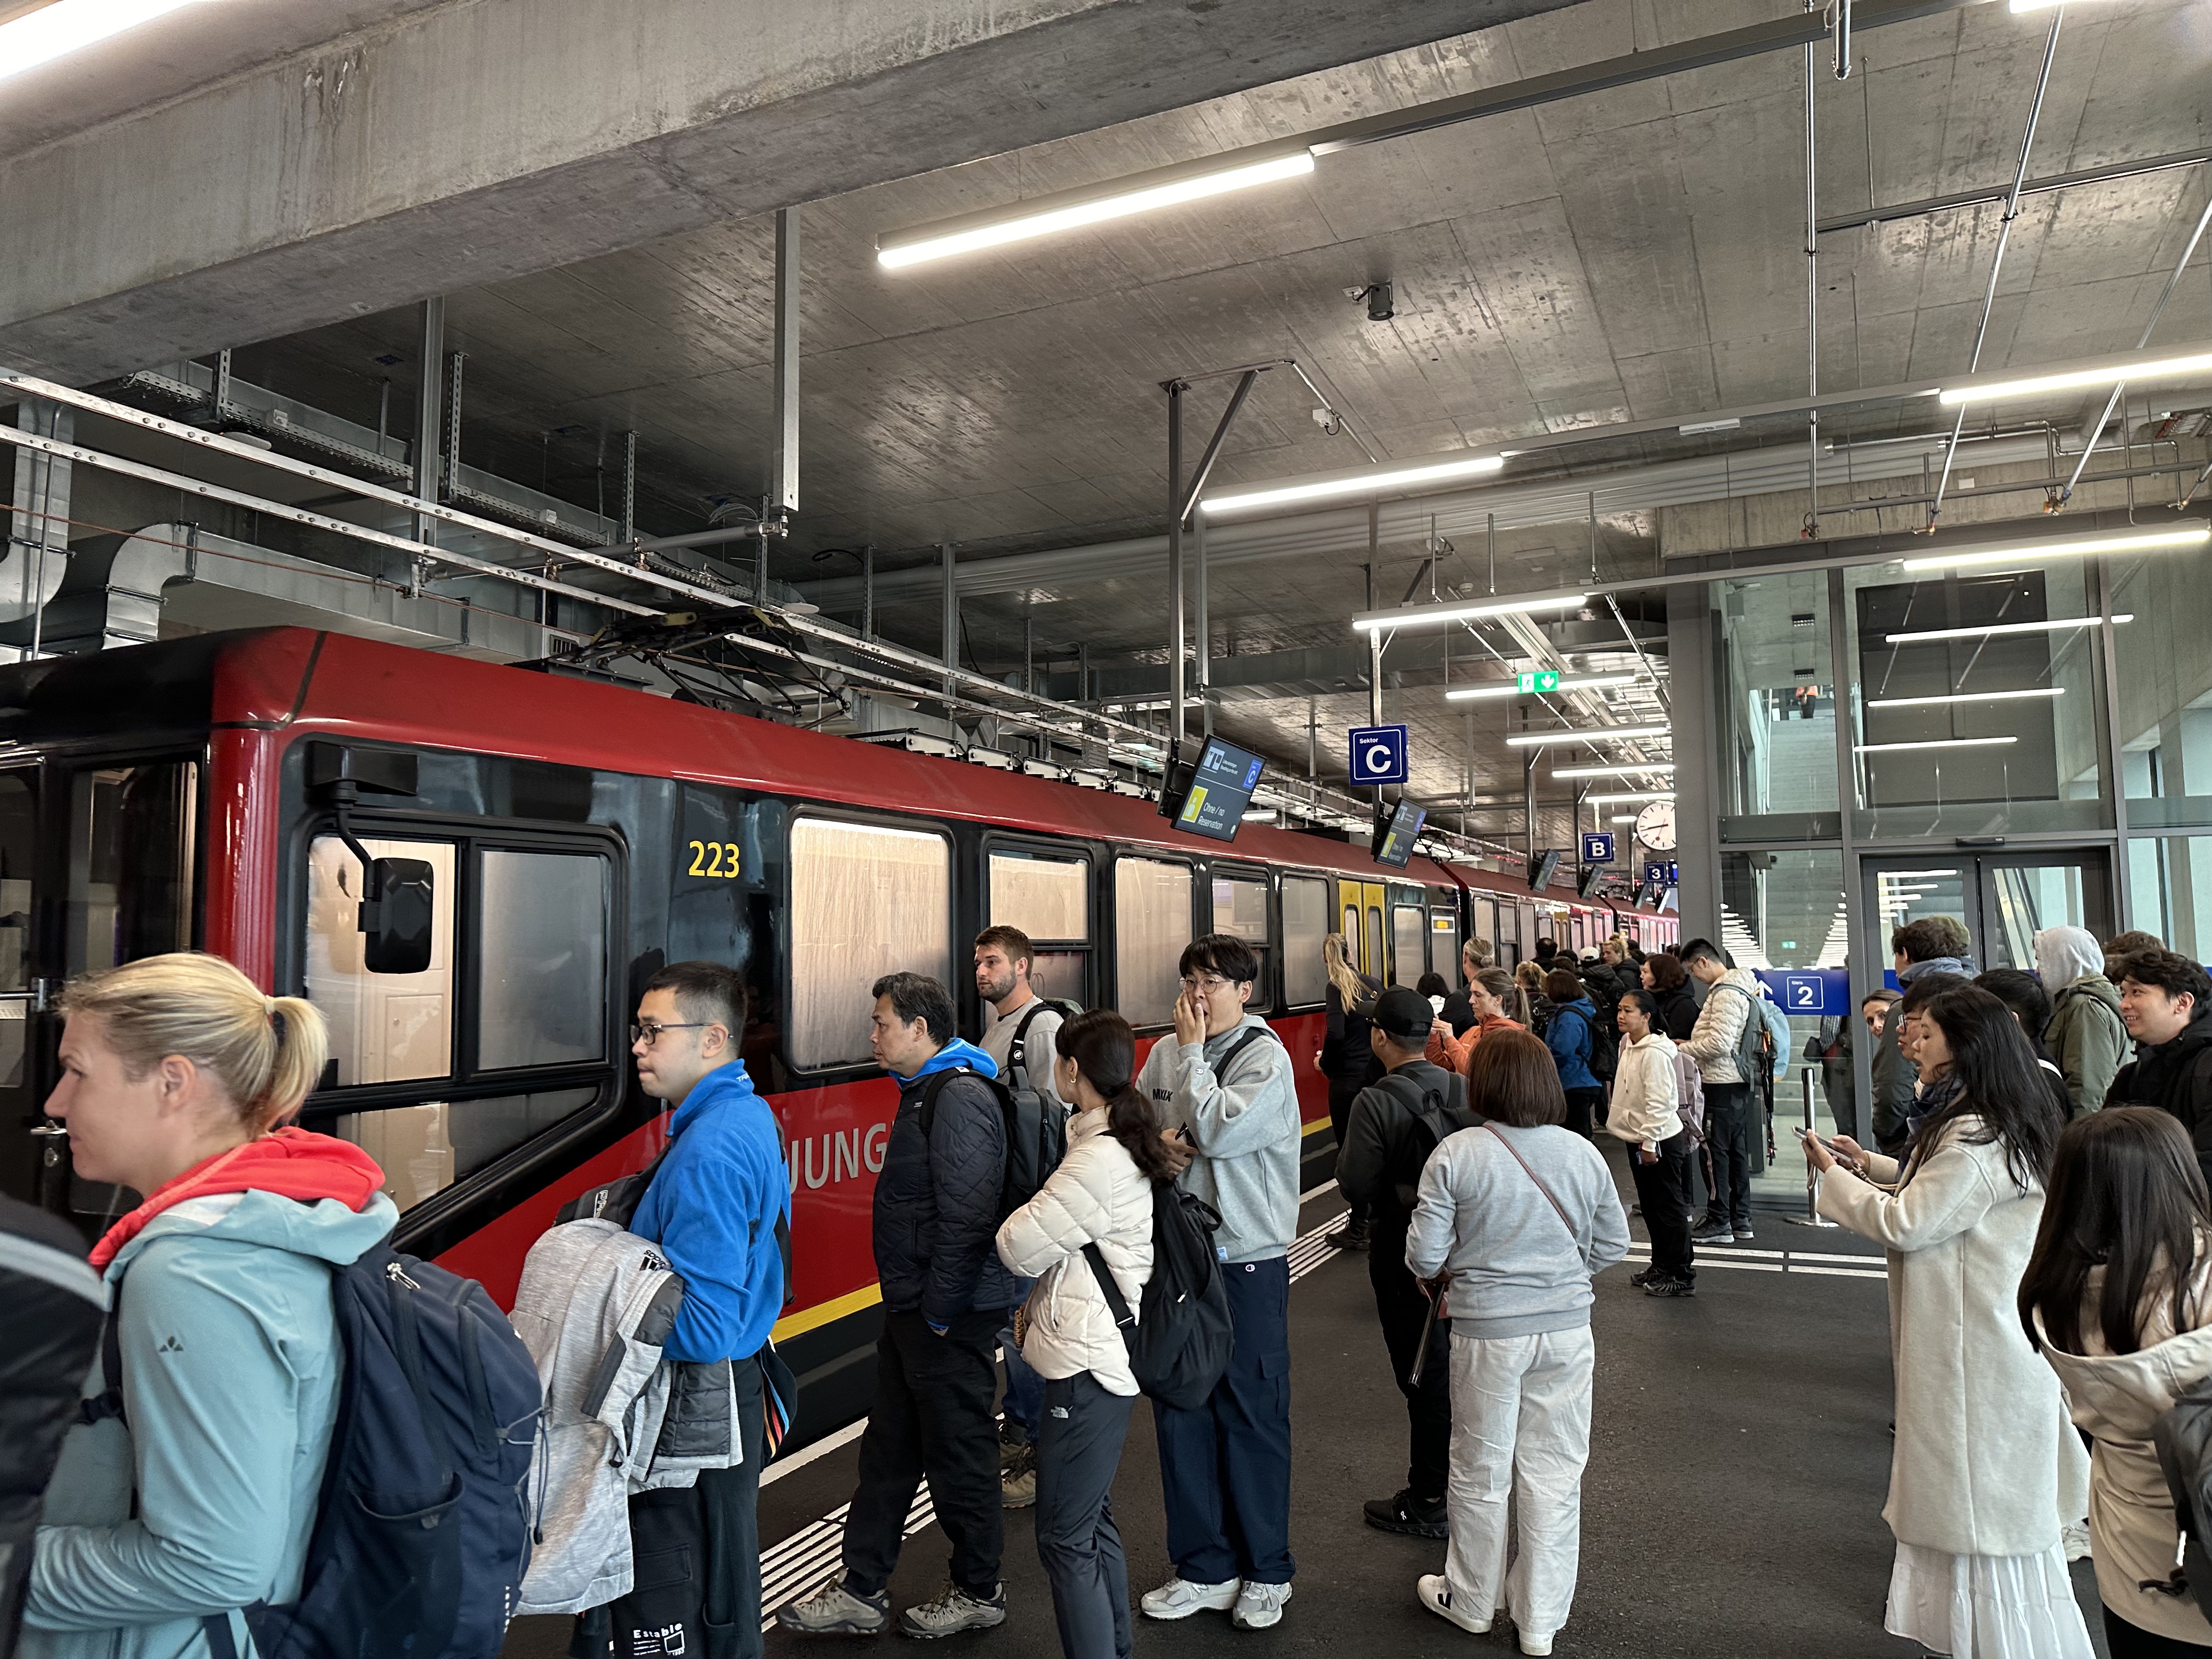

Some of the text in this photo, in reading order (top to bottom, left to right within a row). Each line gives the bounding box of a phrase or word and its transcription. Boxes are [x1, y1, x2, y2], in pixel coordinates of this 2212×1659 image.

[1366, 745, 1391, 773] C
[1203, 802, 1216, 814] Ohne
[1592, 842, 1605, 856] B
[689, 840, 740, 878] 223
[1652, 868, 1661, 879] 3
[1798, 986, 1813, 1005] 2
[790, 1120, 895, 1195] JUNG
